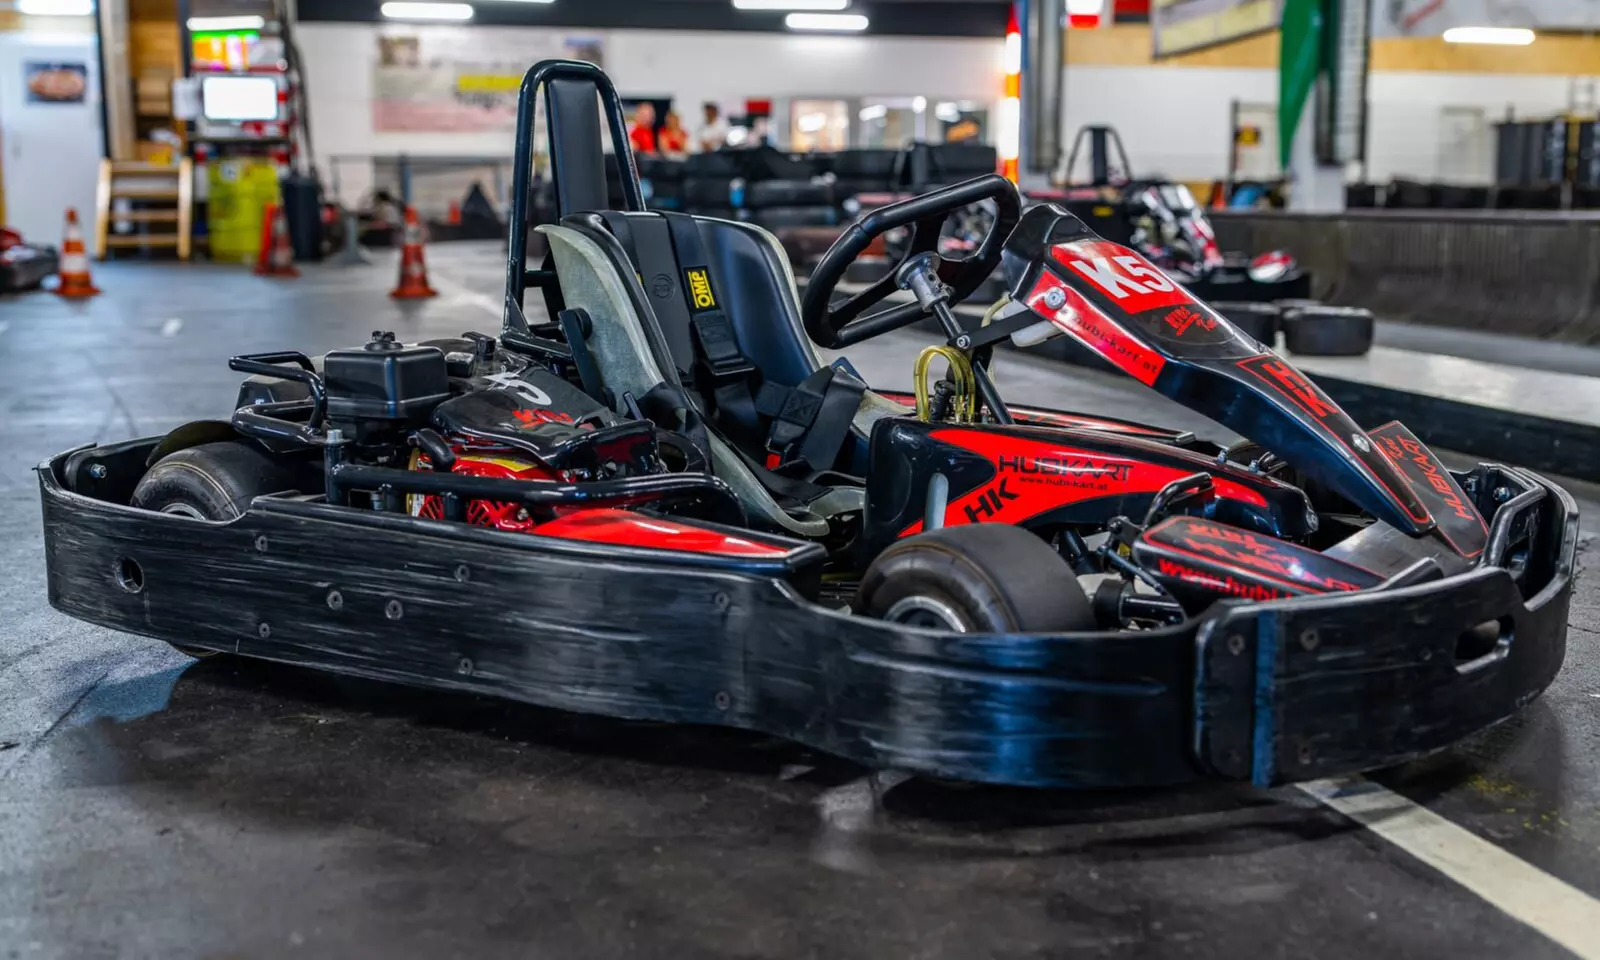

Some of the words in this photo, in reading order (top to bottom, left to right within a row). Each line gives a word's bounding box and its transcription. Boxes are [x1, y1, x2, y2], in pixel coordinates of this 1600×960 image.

[690, 271, 712, 307] OMP
[1070, 255, 1175, 299] K5
[1261, 360, 1339, 417] HK
[963, 478, 1019, 523] HK
[1019, 476, 1108, 490] www.hubi-kart.at
